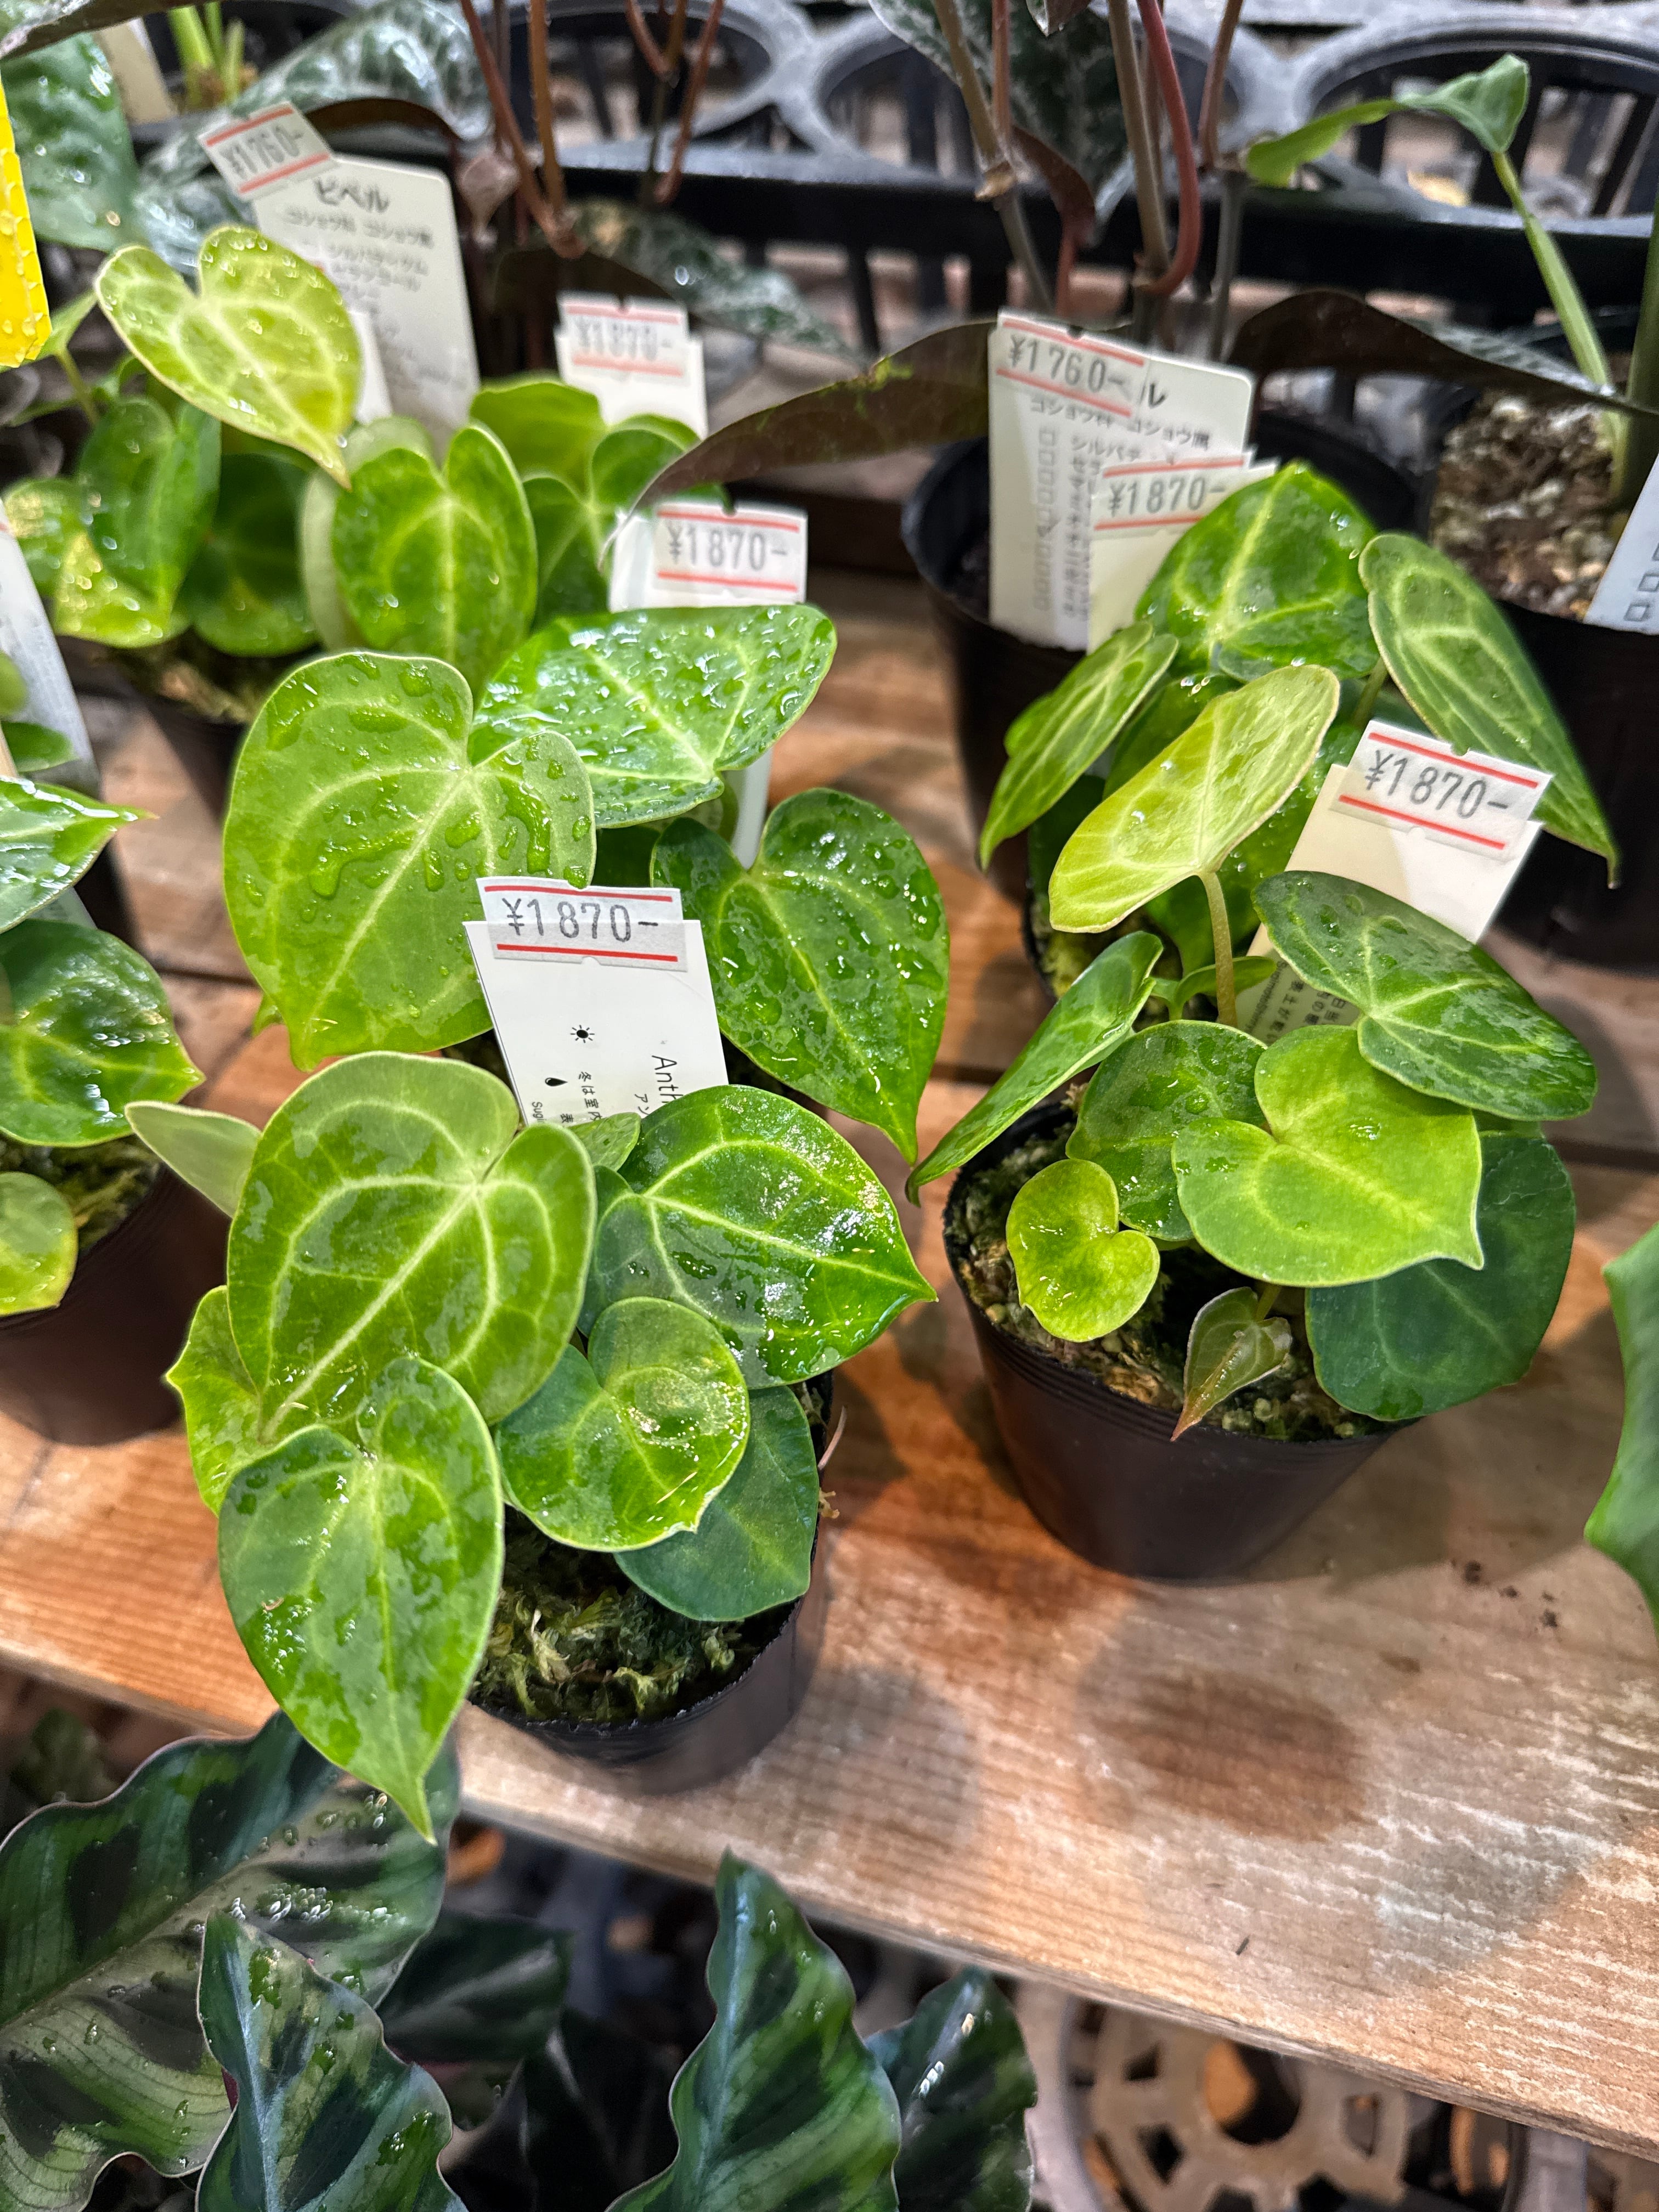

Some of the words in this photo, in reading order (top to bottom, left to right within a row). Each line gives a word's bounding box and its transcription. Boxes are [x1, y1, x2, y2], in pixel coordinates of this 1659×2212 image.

[1009, 334, 1125, 393] ¥1760-
[1108, 476, 1227, 517] ¥1870-
[667, 524, 788, 570] ¥1870-
[1364, 749, 1509, 819] ¥1870-
[502, 897, 659, 943] ¥1870-
[578, 1070, 602, 1122] 冬は室内
[651, 1054, 684, 1103] Anth
[560, 1113, 574, 1124] 表
